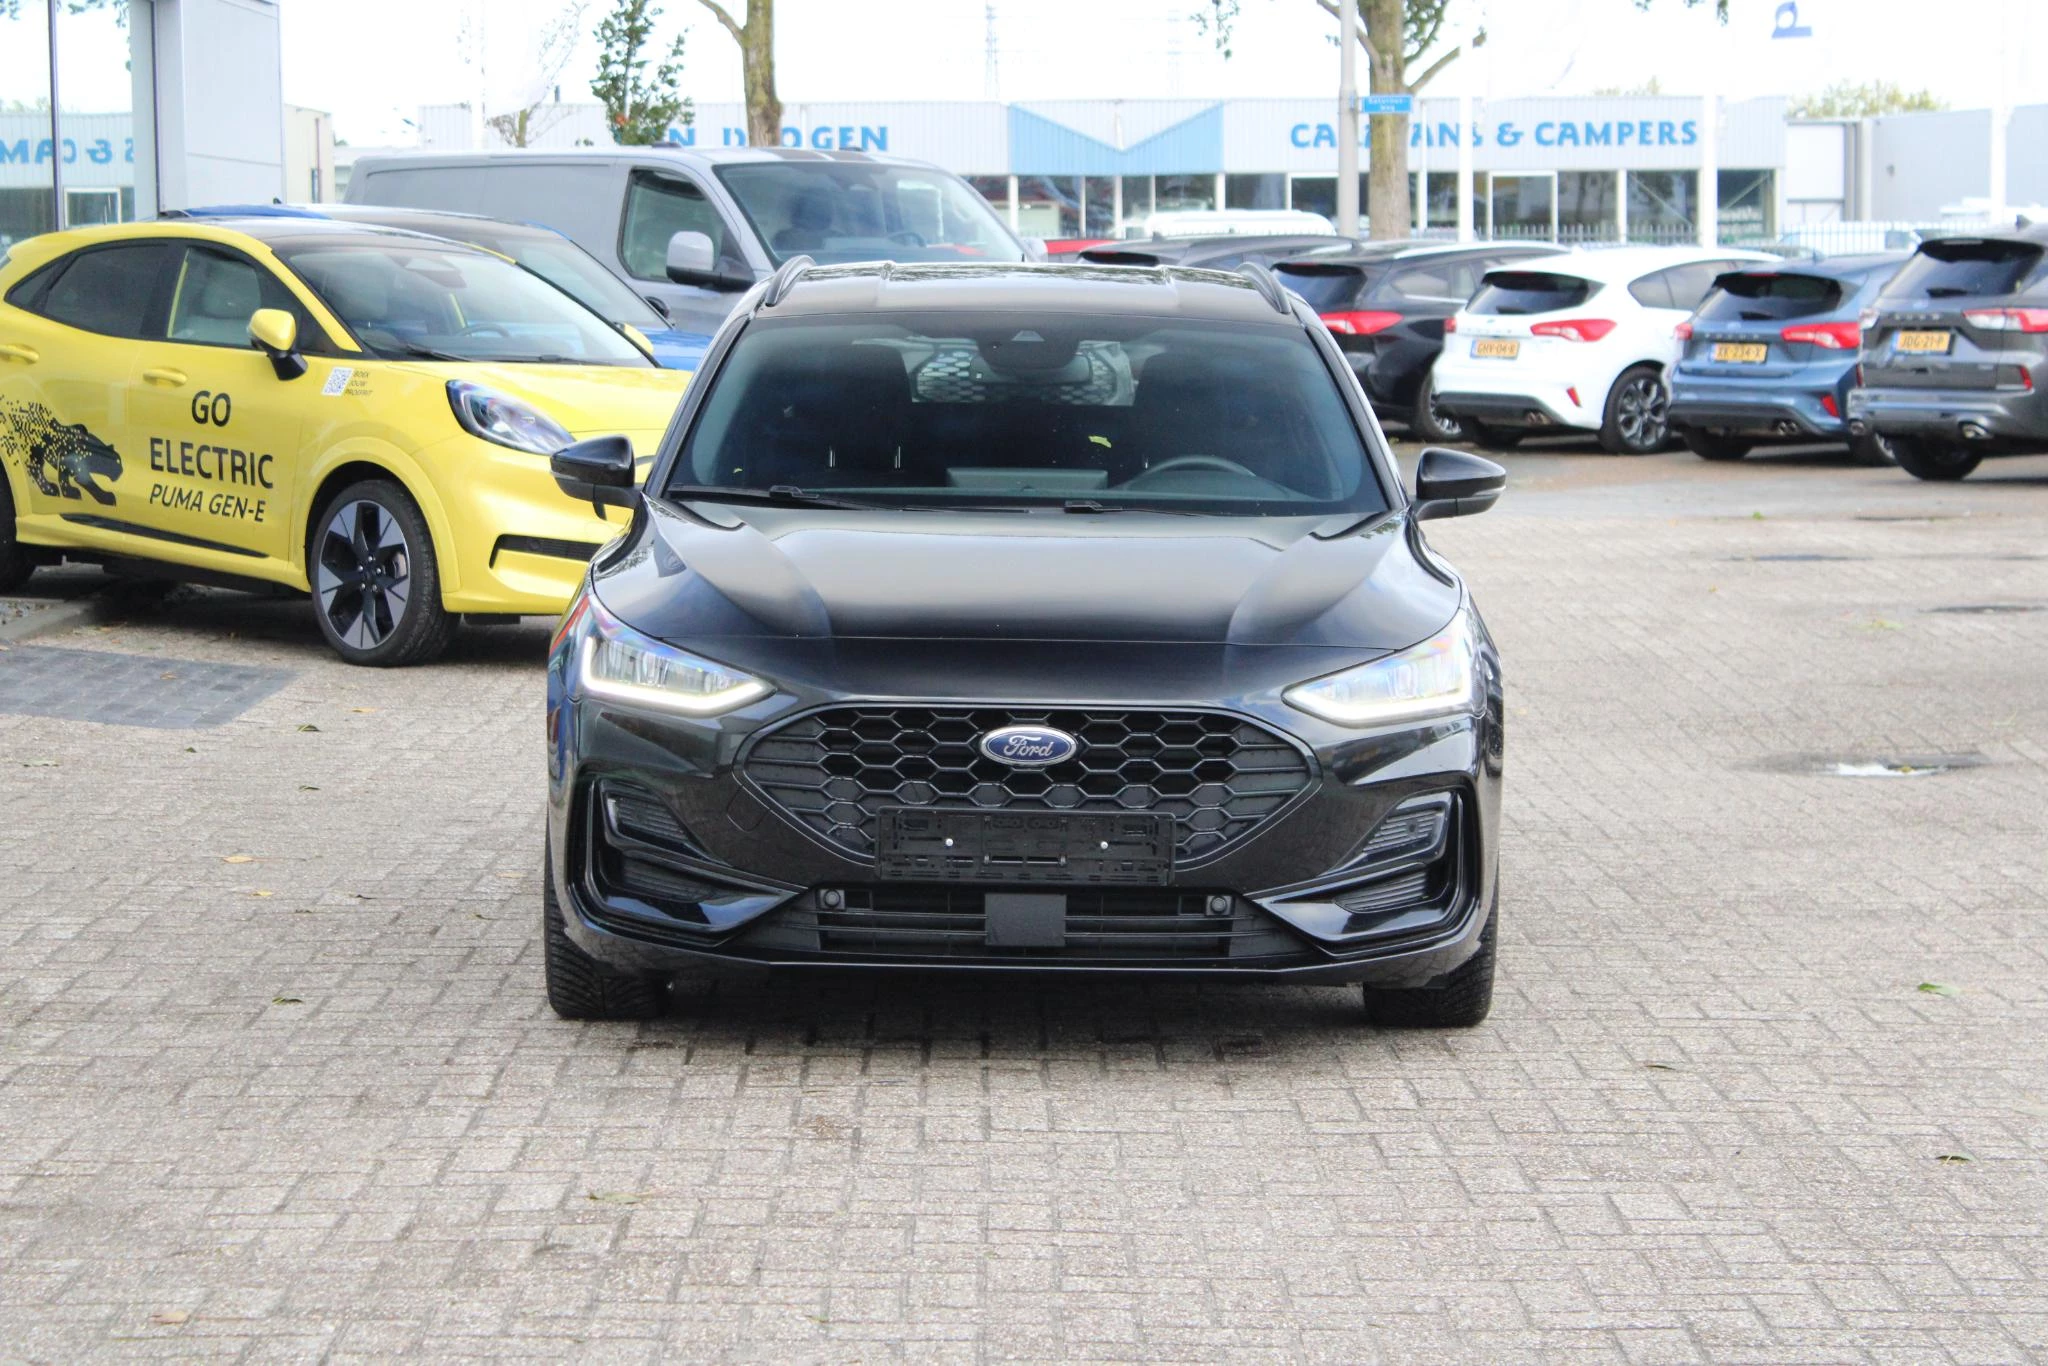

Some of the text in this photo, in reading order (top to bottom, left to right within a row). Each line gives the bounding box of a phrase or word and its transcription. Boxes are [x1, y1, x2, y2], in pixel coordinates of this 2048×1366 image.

[722, 125, 888, 151] DOGEN
[1496, 122, 1524, 147] &
[1535, 120, 1698, 147] CAMPERS
[191, 390, 231, 427] GO
[150, 437, 273, 489] ELECTRIC
[150, 483, 266, 522] PUMA GEN-E
[1003, 735, 1054, 757] Ford
